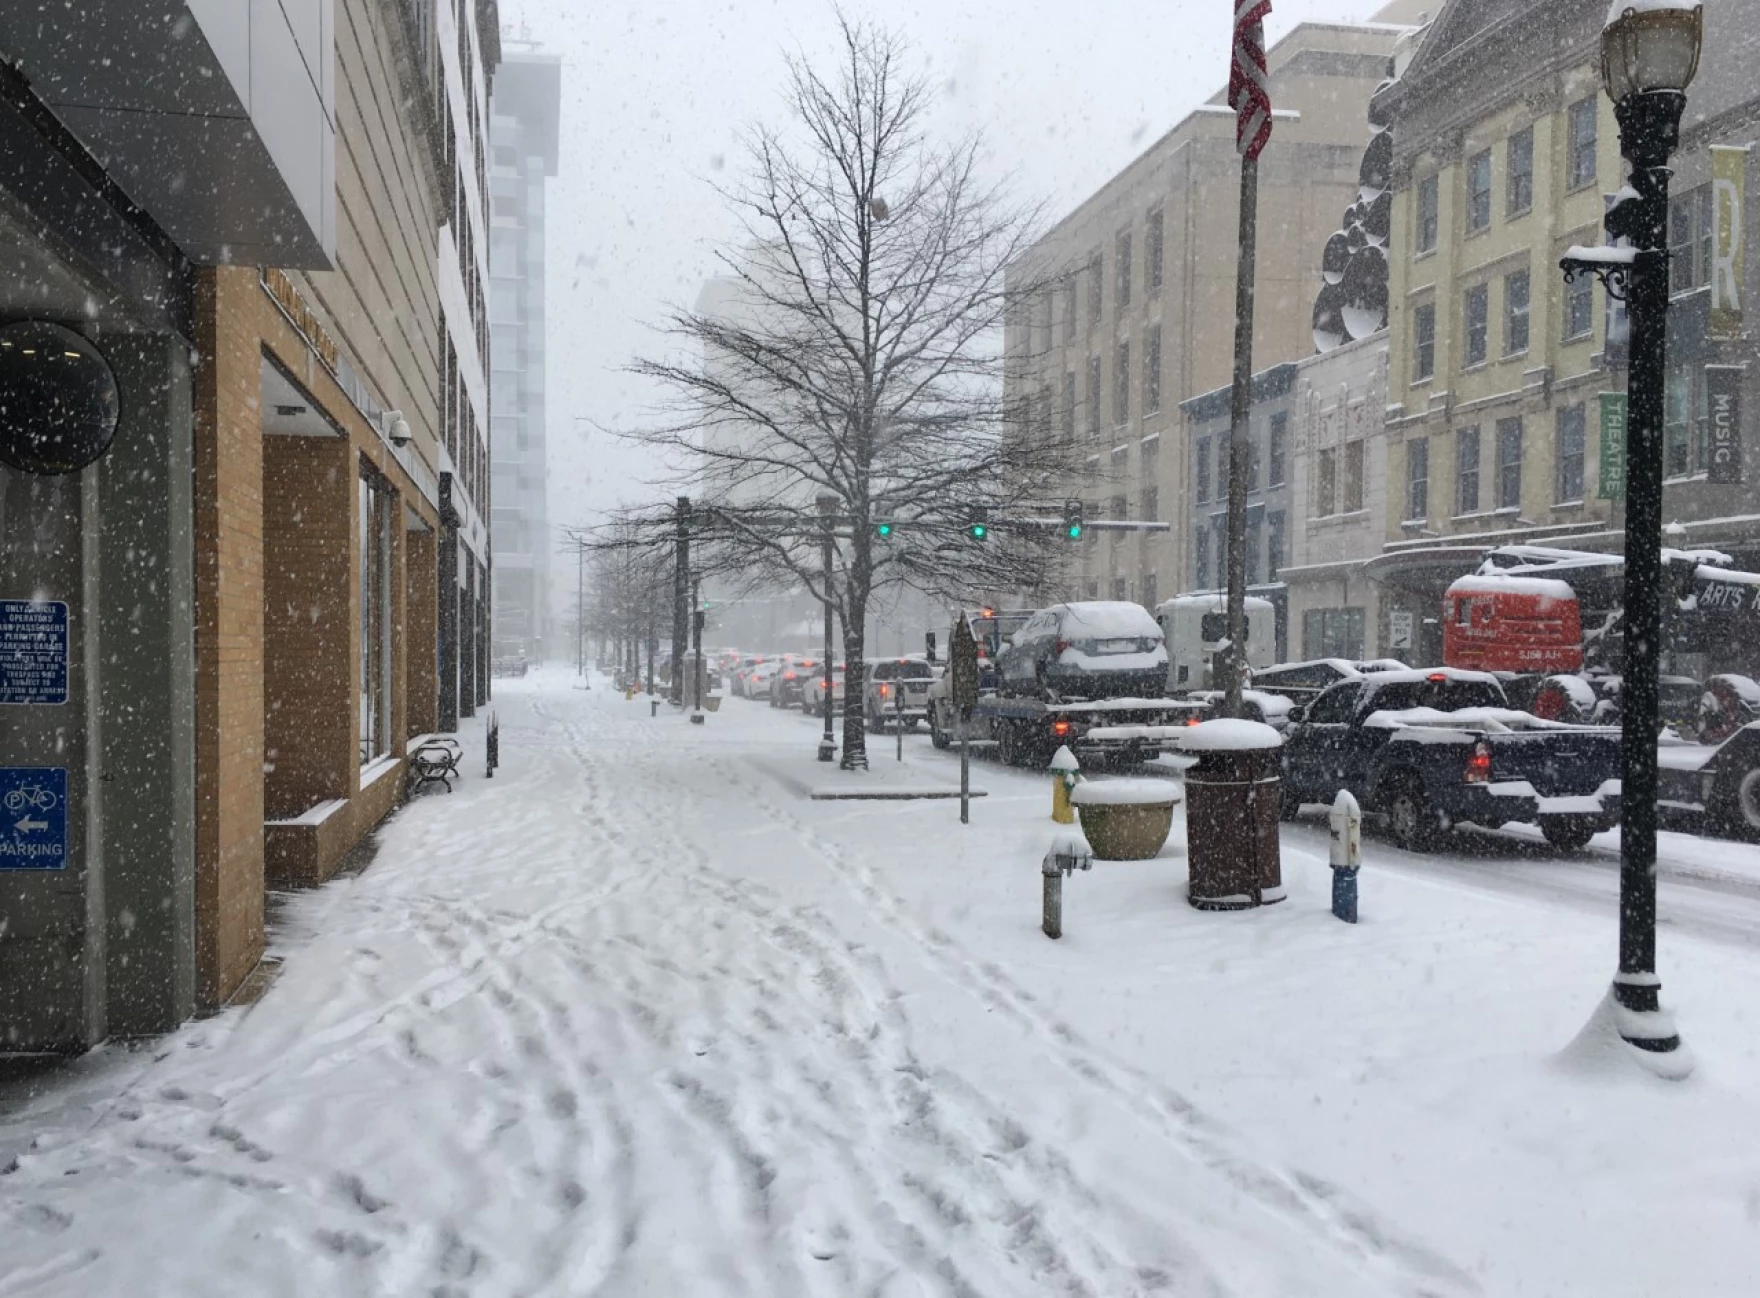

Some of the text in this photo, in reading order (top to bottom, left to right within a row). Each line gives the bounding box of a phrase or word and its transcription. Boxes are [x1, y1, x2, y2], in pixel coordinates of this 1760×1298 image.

[1605, 402, 1622, 492] THEATRE
[1714, 394, 1731, 463] MUSIC
[5, 604, 24, 613] ONLY
[0, 843, 63, 856] PARKING
